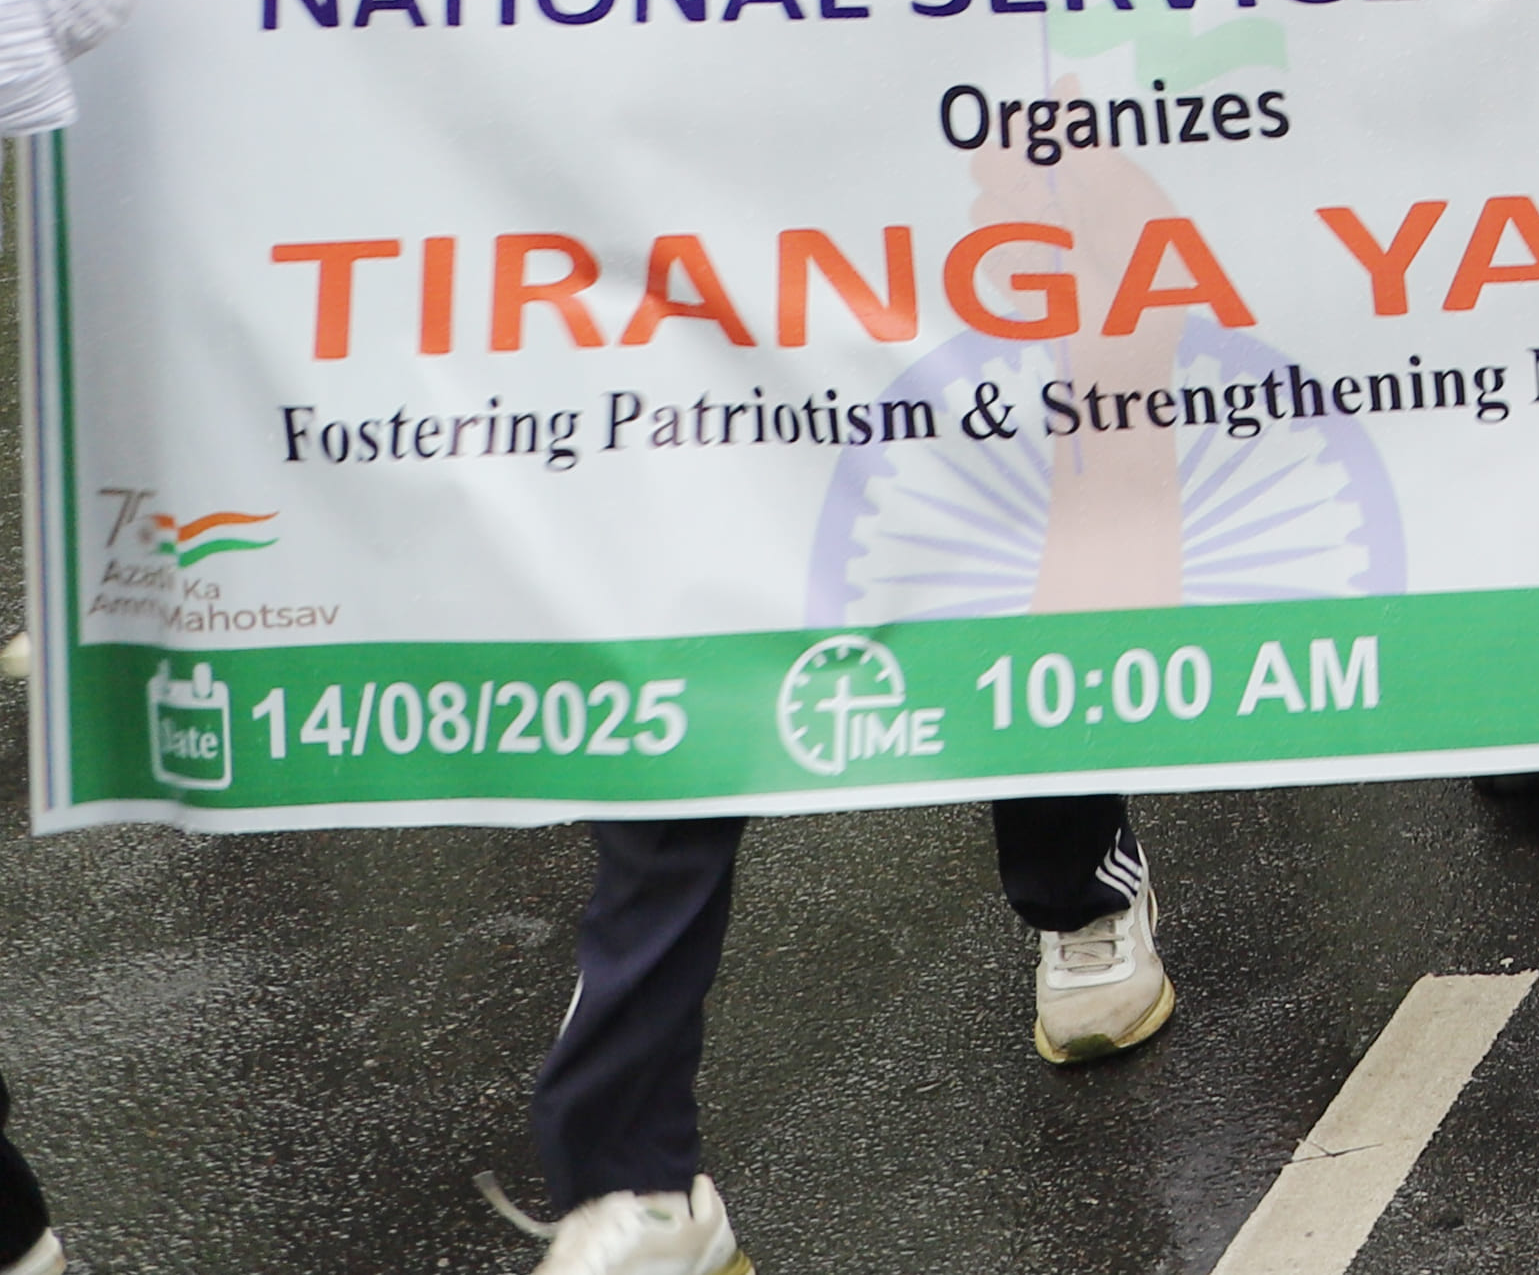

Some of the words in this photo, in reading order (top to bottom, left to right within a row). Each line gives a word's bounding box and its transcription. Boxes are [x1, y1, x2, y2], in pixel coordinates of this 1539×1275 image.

[938, 77, 1291, 167] Organizes
[269, 217, 1258, 360] TIRANGA
[281, 394, 578, 472] Fostering
[601, 382, 939, 454] Patriotism
[959, 383, 1019, 441] &
[1042, 354, 1509, 439] Strengthening
[183, 579, 221, 601] Ka
[251, 679, 688, 759] 14/08/2025
[975, 645, 1212, 731] 10:00
[1237, 636, 1380, 718] AM
